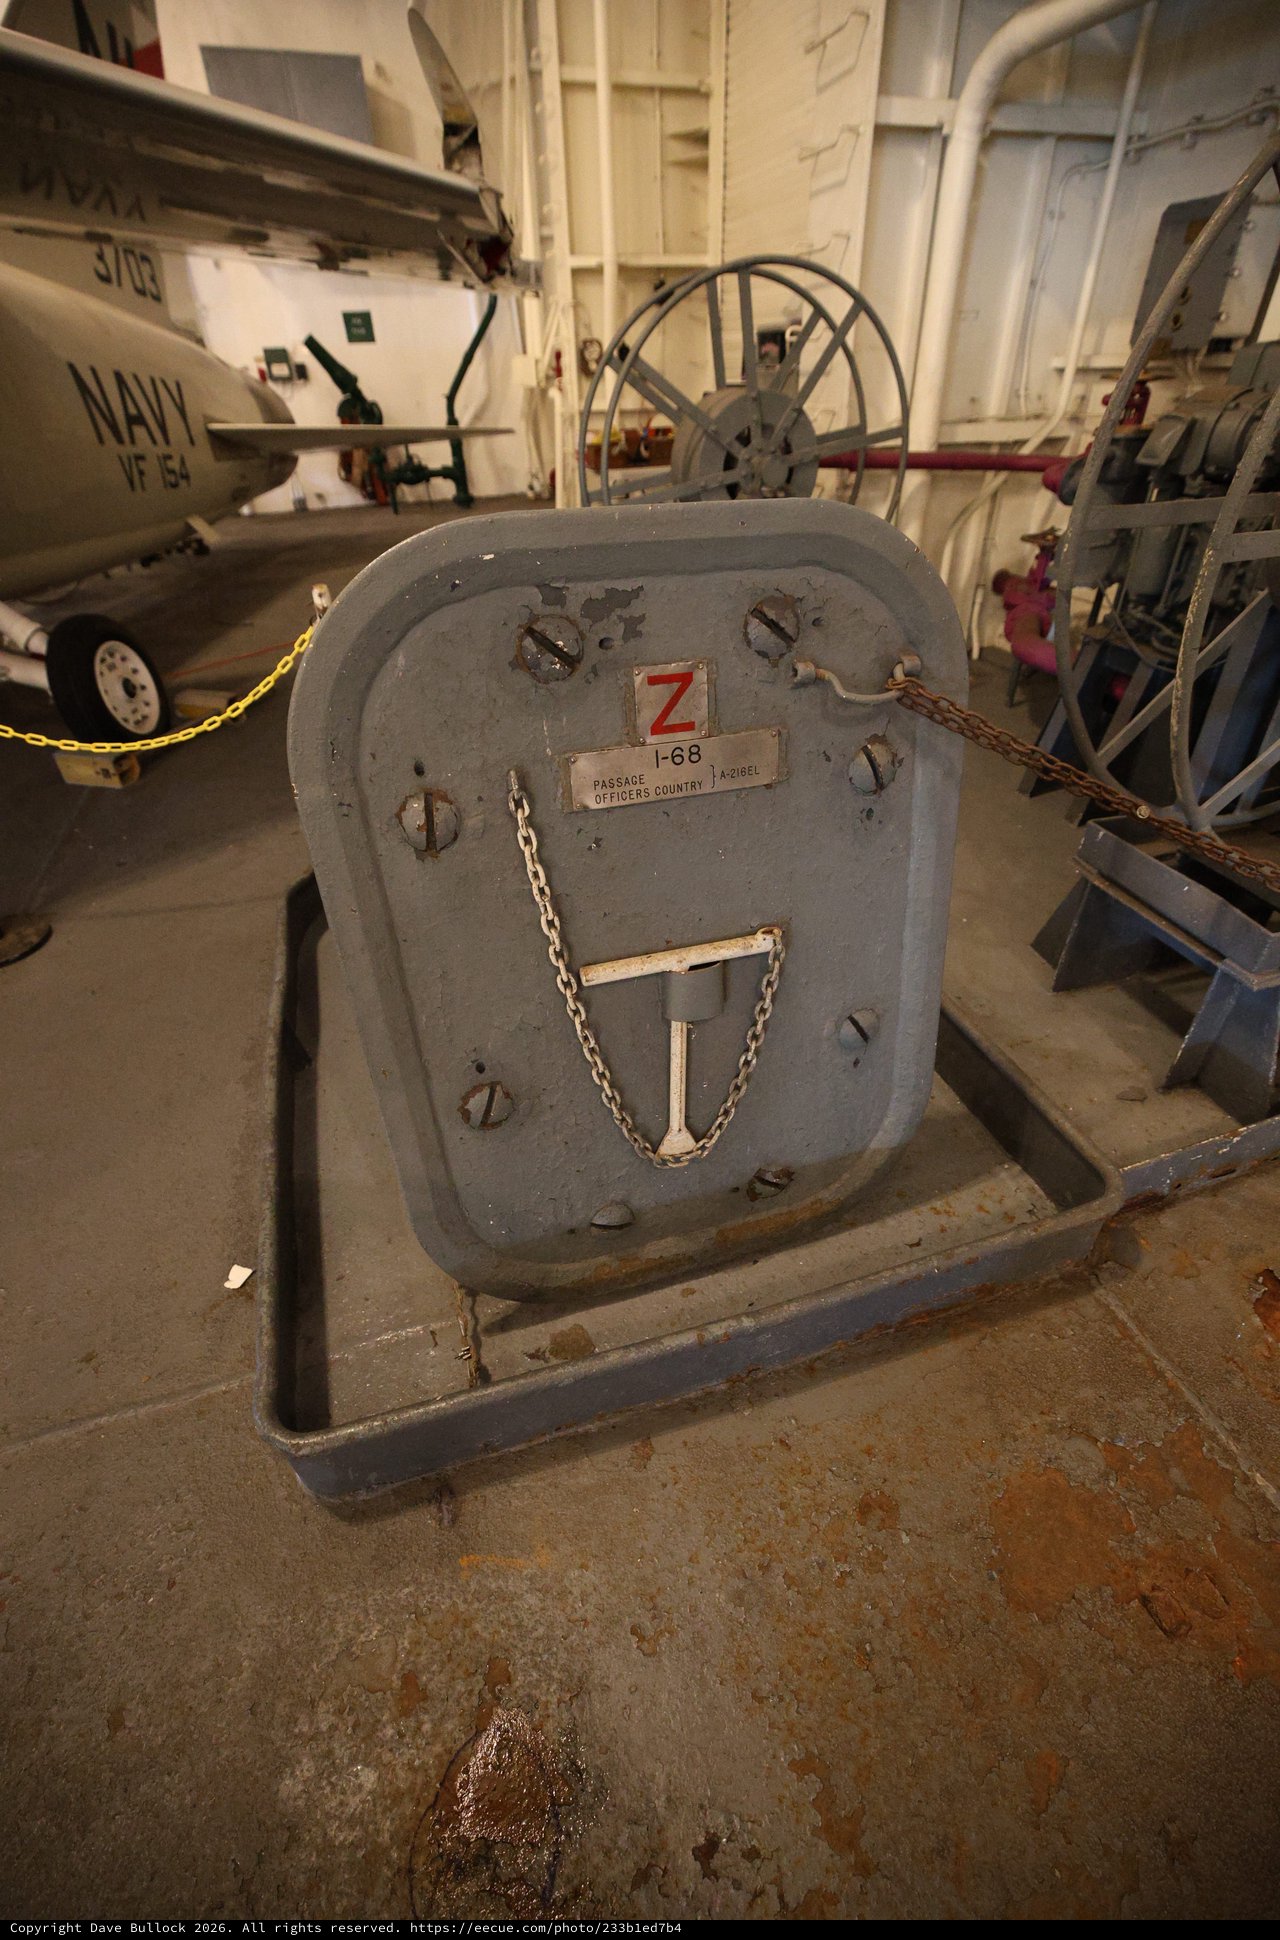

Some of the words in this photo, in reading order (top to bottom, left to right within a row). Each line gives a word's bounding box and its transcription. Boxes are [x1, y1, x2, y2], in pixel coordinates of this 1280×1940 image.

[67, 361, 196, 447] NAVY
[117, 454, 146, 492] VF
[156, 453, 191, 489] 154
[647, 672, 696, 736] Z
[593, 774, 645, 790] PASSAGE
[595, 788, 650, 805] OFFICERS
[655, 780, 703, 796] COUNTRY
